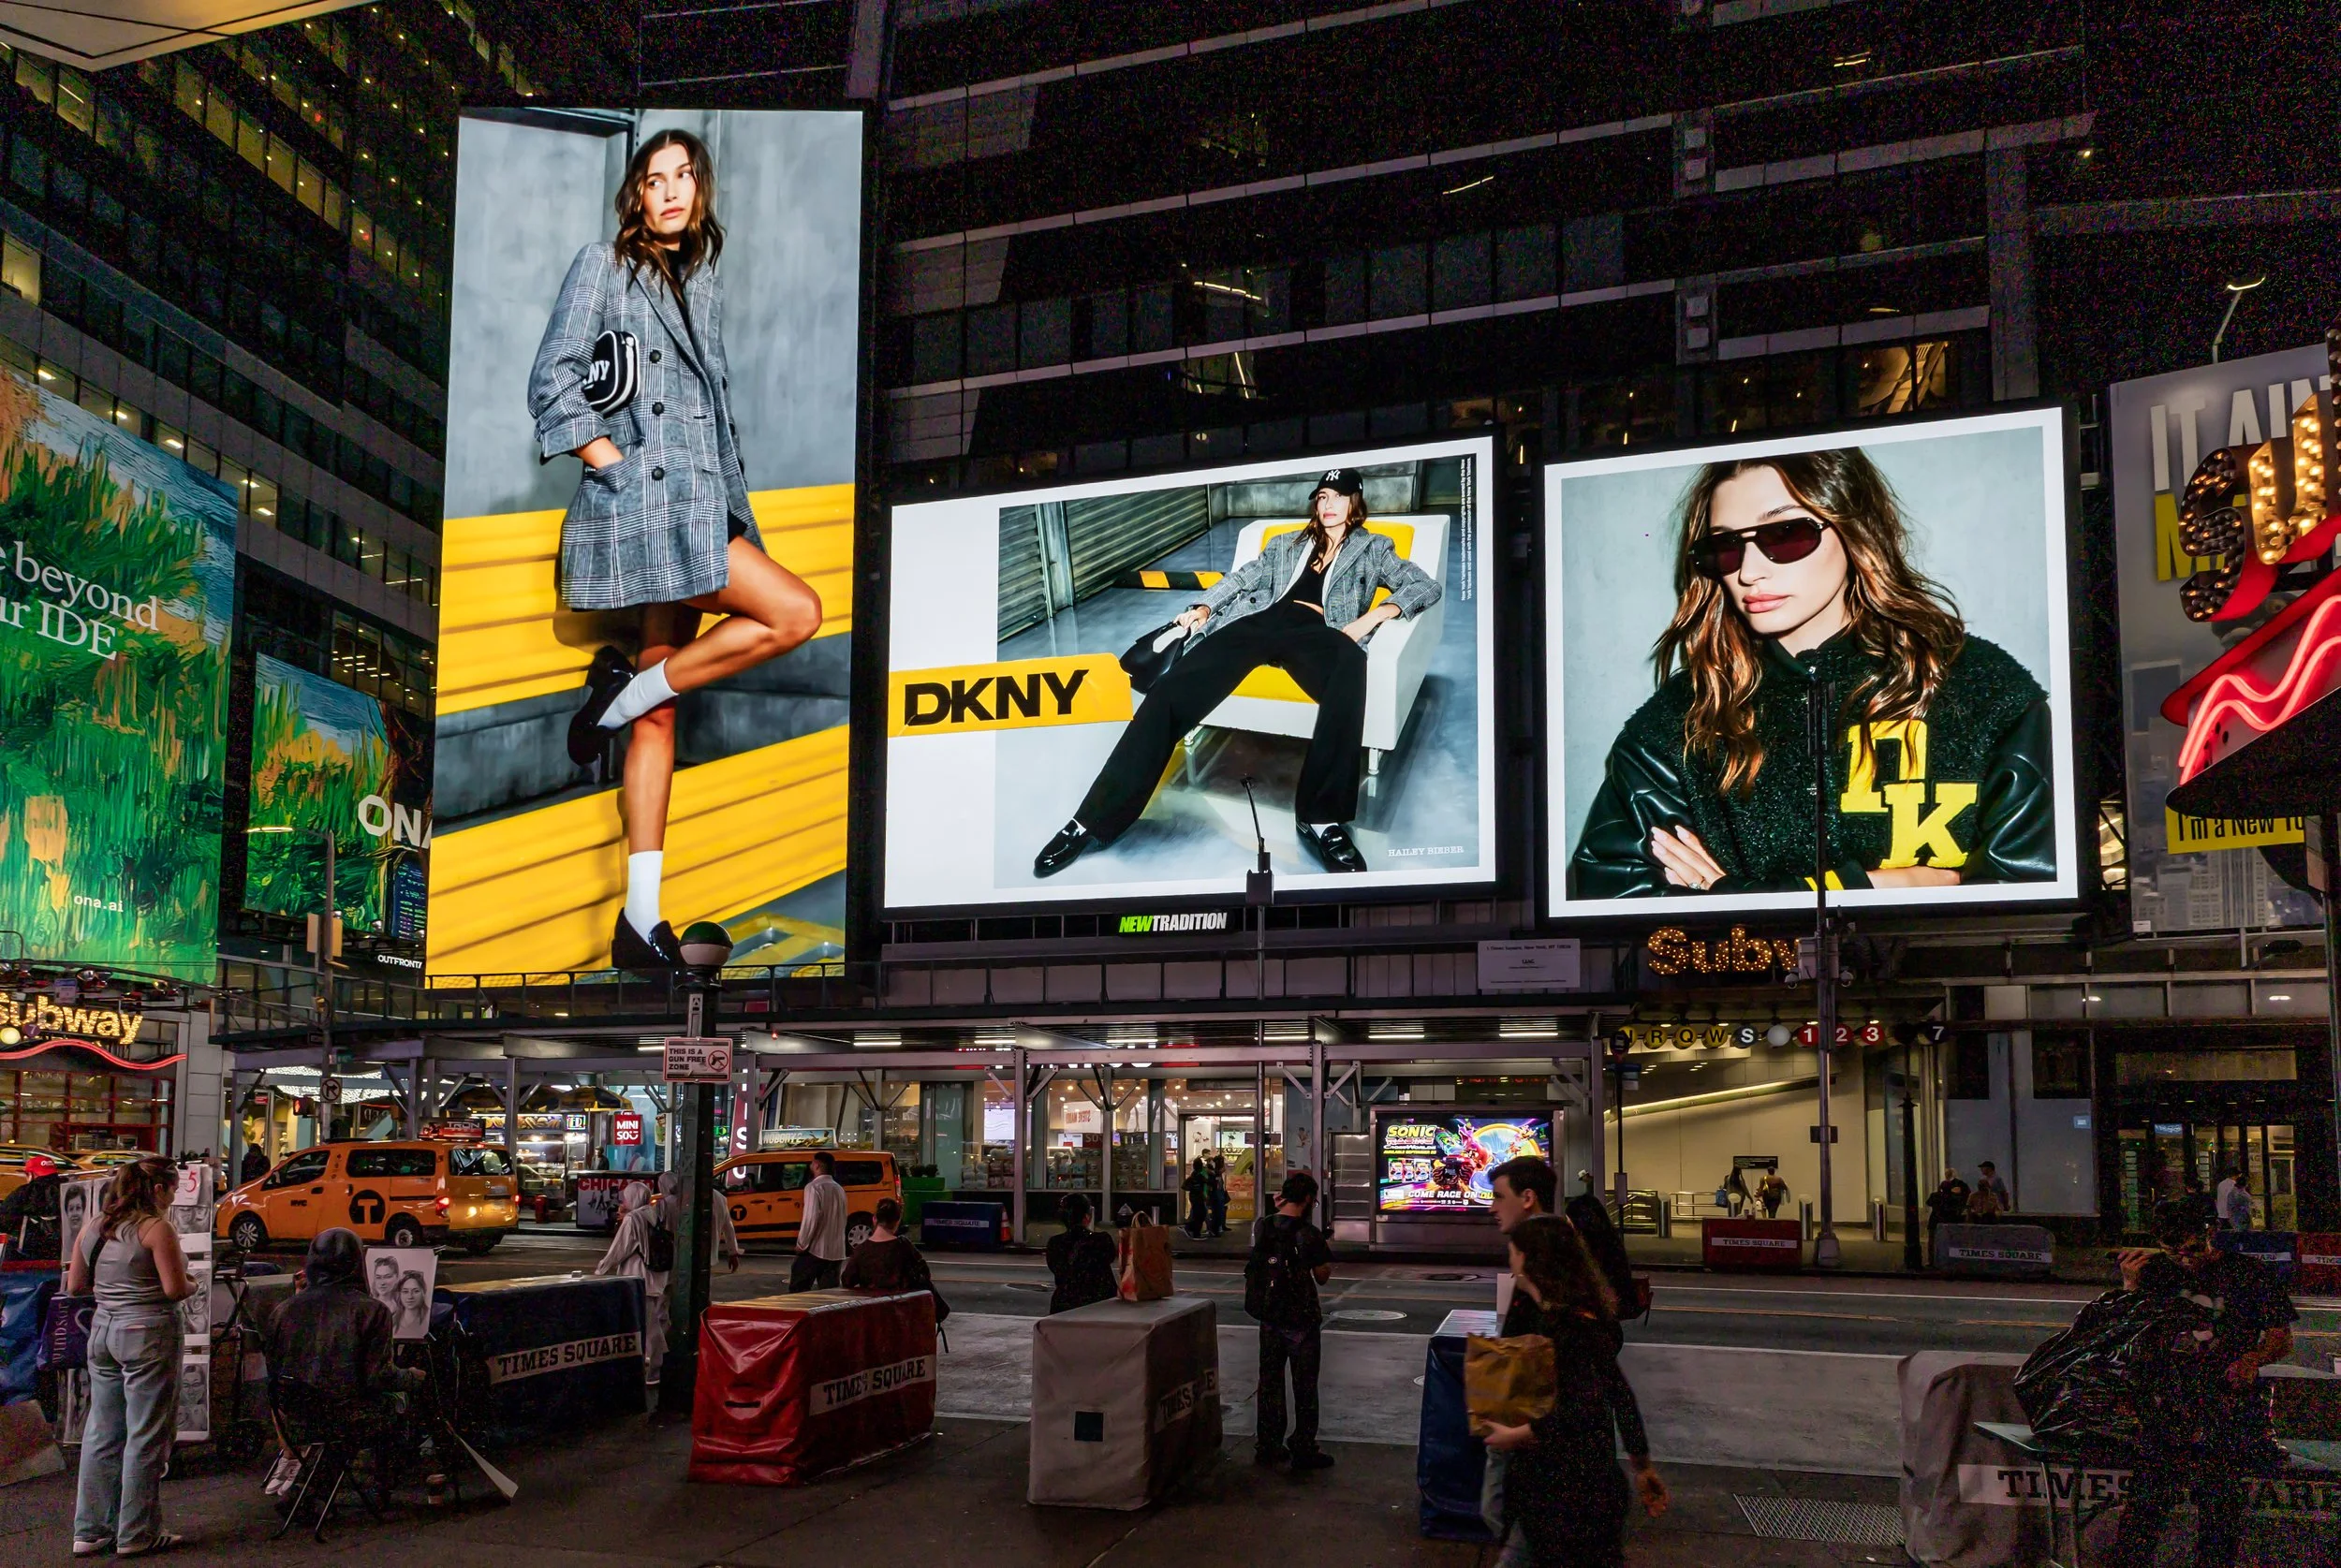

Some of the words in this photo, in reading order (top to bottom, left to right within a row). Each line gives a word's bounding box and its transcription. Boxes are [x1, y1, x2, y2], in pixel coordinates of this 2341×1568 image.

[2150, 397, 2206, 492] IT
[14, 540, 159, 631] beyond
[37, 599, 117, 661] IDE
[905, 669, 1089, 726] DKNY
[2232, 818, 2275, 836] New
[1388, 847, 1425, 857] HAILEY
[1427, 845, 1465, 855] BIEBER
[74, 895, 124, 913] ona.ai
[1651, 1030, 1663, 1044] R
[1680, 1030, 1694, 1044] Q
[1707, 1030, 1726, 1043] W
[1740, 1029, 1754, 1044] S
[1804, 1029, 1813, 1043] 1
[1835, 1028, 1848, 1042] 2
[1866, 1027, 1879, 1042] 3
[1932, 1026, 1945, 1041] 7
[447, 1121, 479, 1129] TRON
[616, 1121, 639, 1130] MINI
[1387, 1125, 1437, 1139] SONIC
[184, 1171, 197, 1193] 5
[1408, 1190, 1435, 1198] COME
[1437, 1190, 1461, 1198] RACE
[1464, 1190, 1478, 1198] ON
[1480, 1191, 1495, 1199] OU
[358, 1199, 378, 1224] T
[1959, 1249, 1995, 1258] TIMES
[1997, 1250, 2042, 1260] SQUARE
[497, 1347, 559, 1377] TIMES
[564, 1335, 637, 1363] SQUARE
